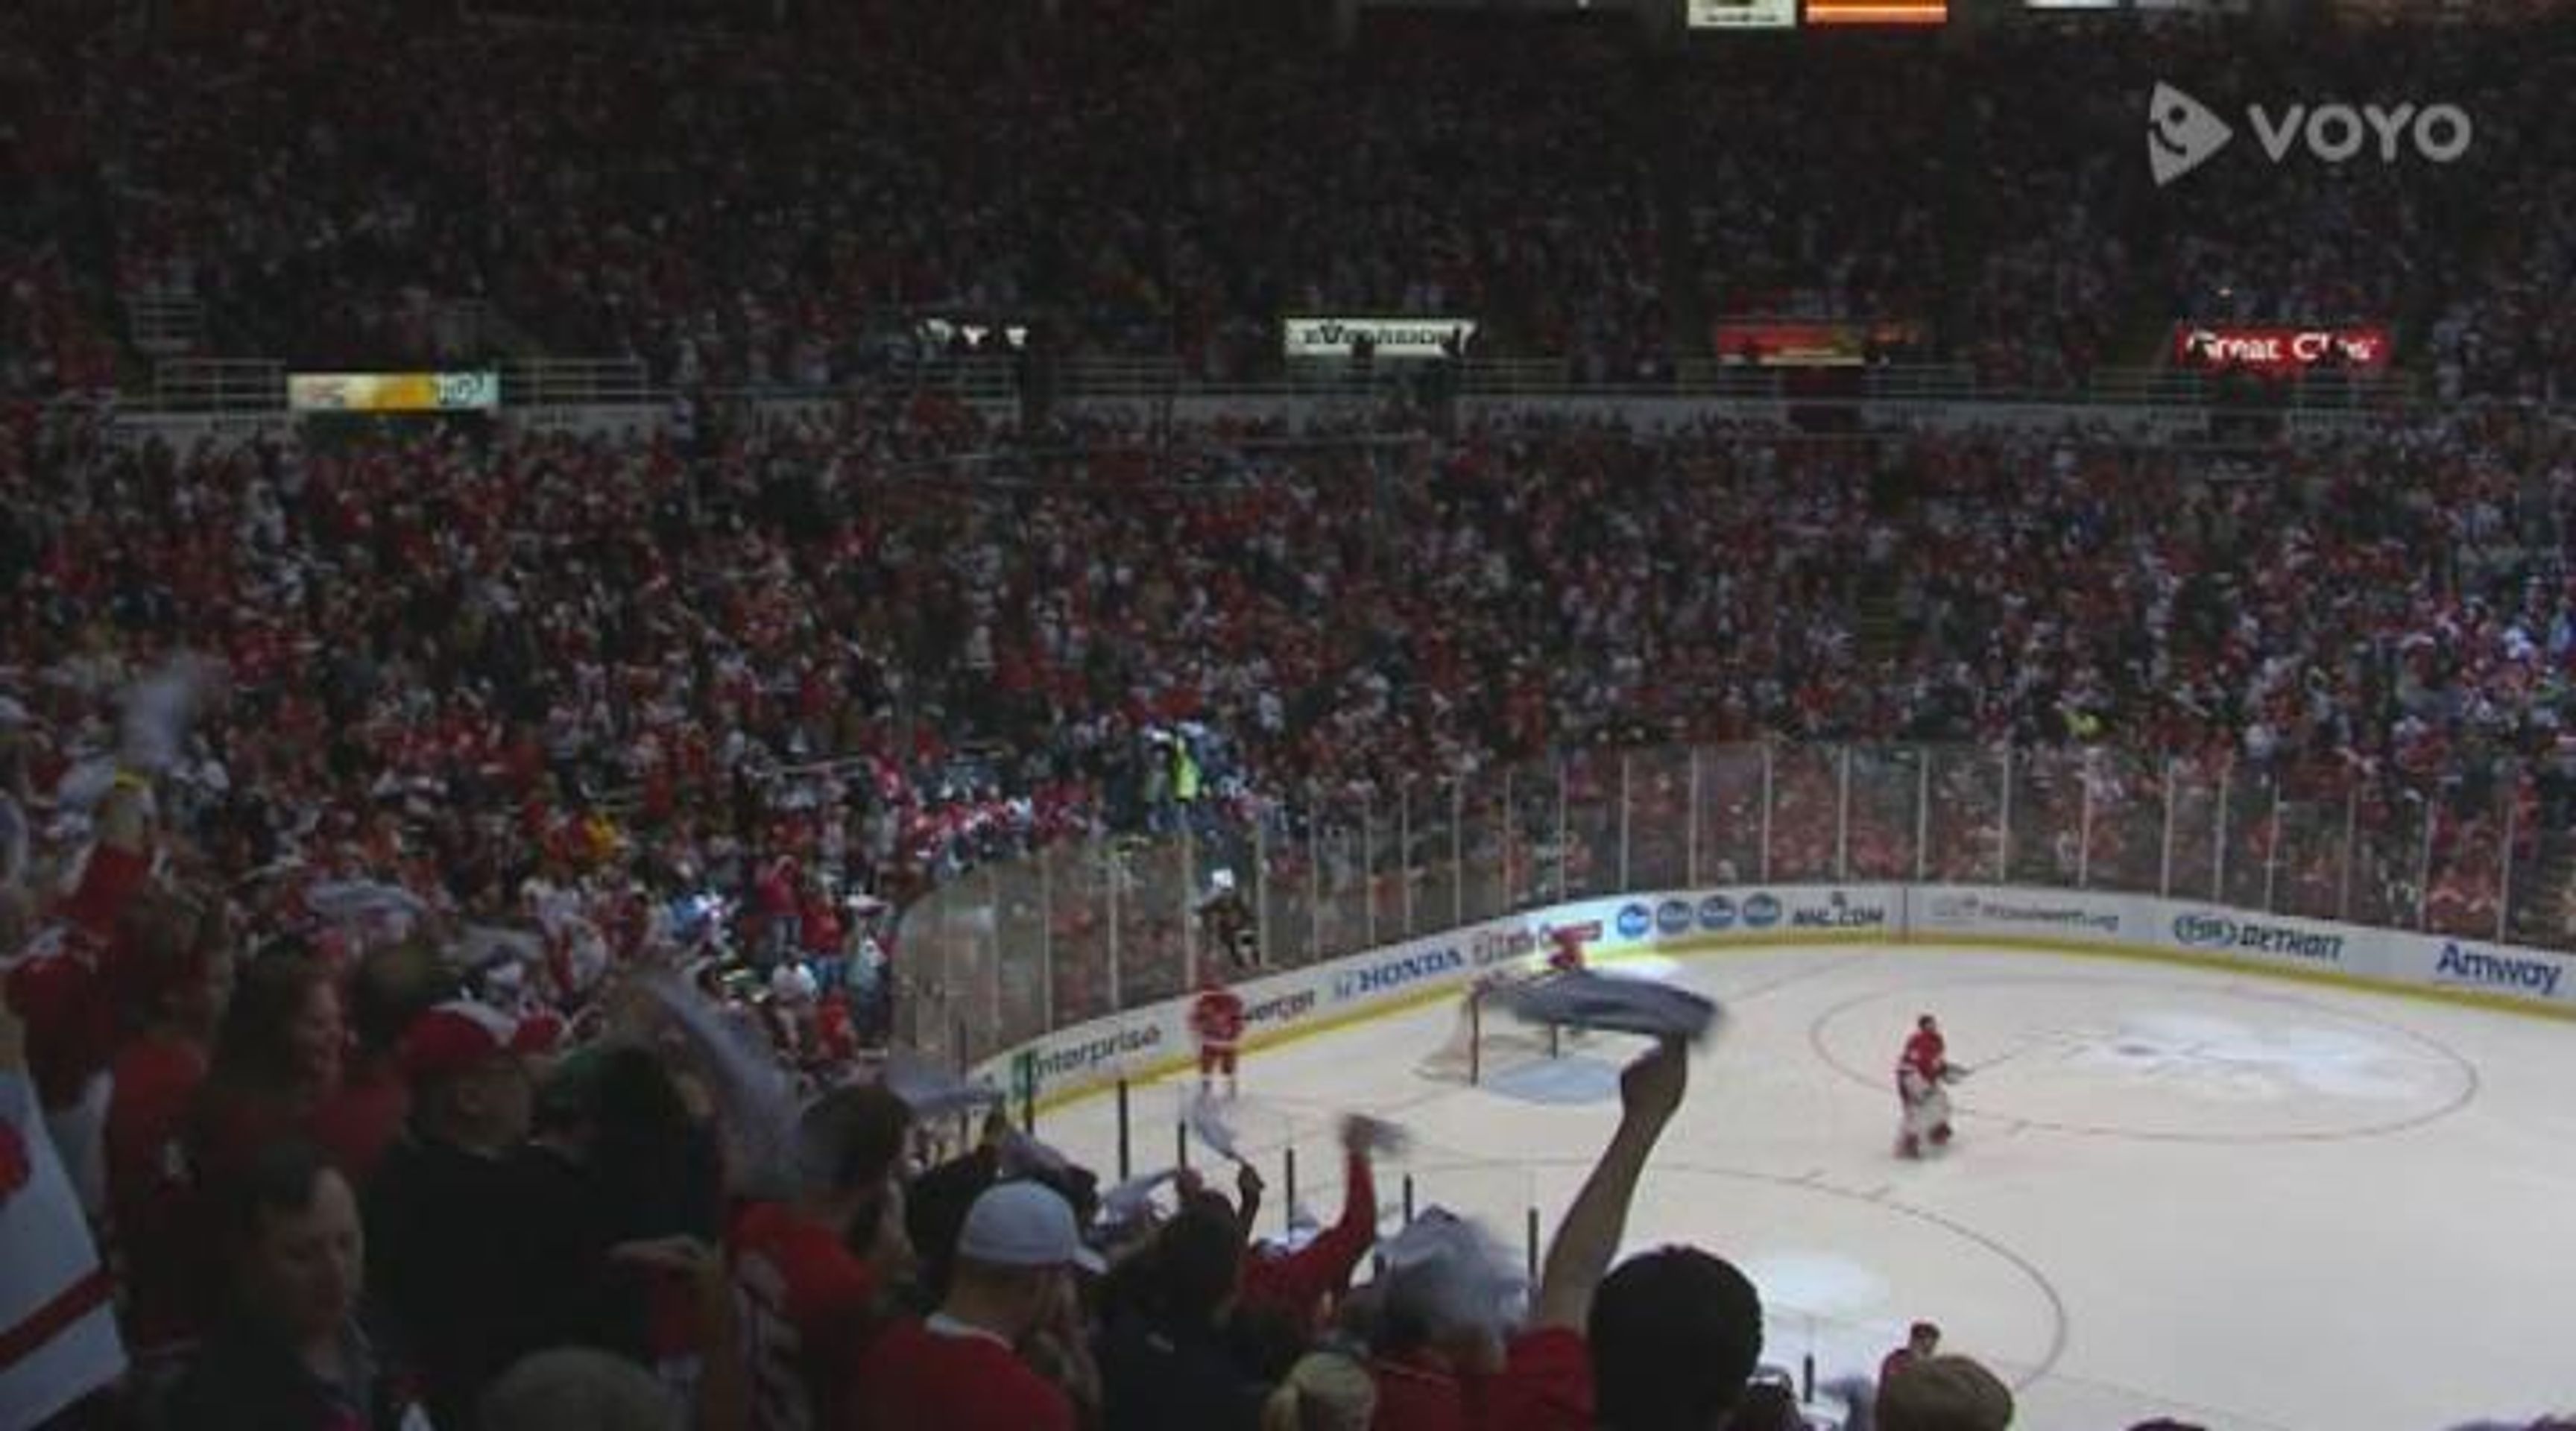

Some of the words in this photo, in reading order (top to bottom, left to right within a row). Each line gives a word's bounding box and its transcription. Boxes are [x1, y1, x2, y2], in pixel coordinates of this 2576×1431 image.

[2241, 924, 2343, 961] DETROIT
[1360, 949, 1461, 993] HONDA
[2437, 942, 2563, 996] Amway
